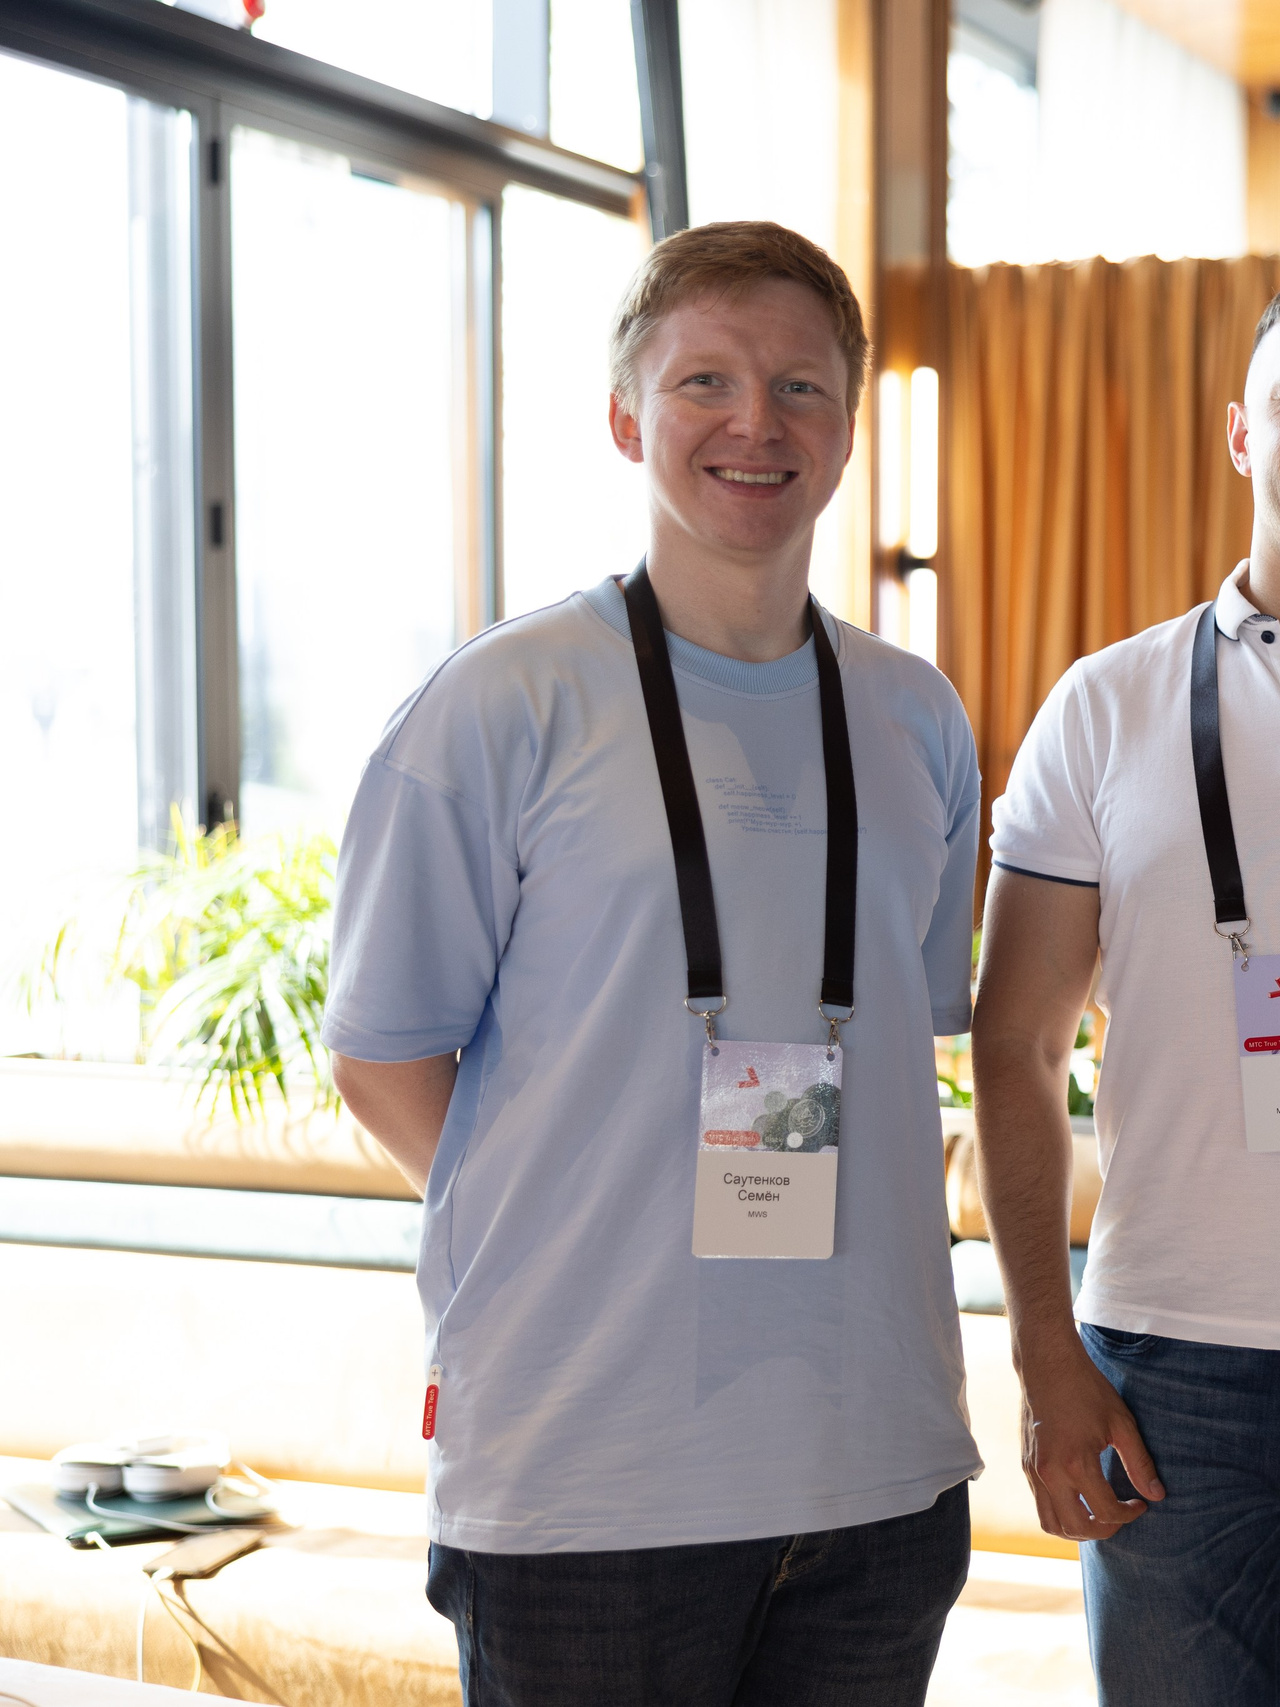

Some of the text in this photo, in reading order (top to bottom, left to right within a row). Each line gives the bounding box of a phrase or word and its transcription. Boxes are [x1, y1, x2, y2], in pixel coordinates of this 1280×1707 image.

[723, 1172, 791, 1188] Саутенков
[737, 1189, 780, 1202] Семён
[747, 1210, 768, 1218] MWS
